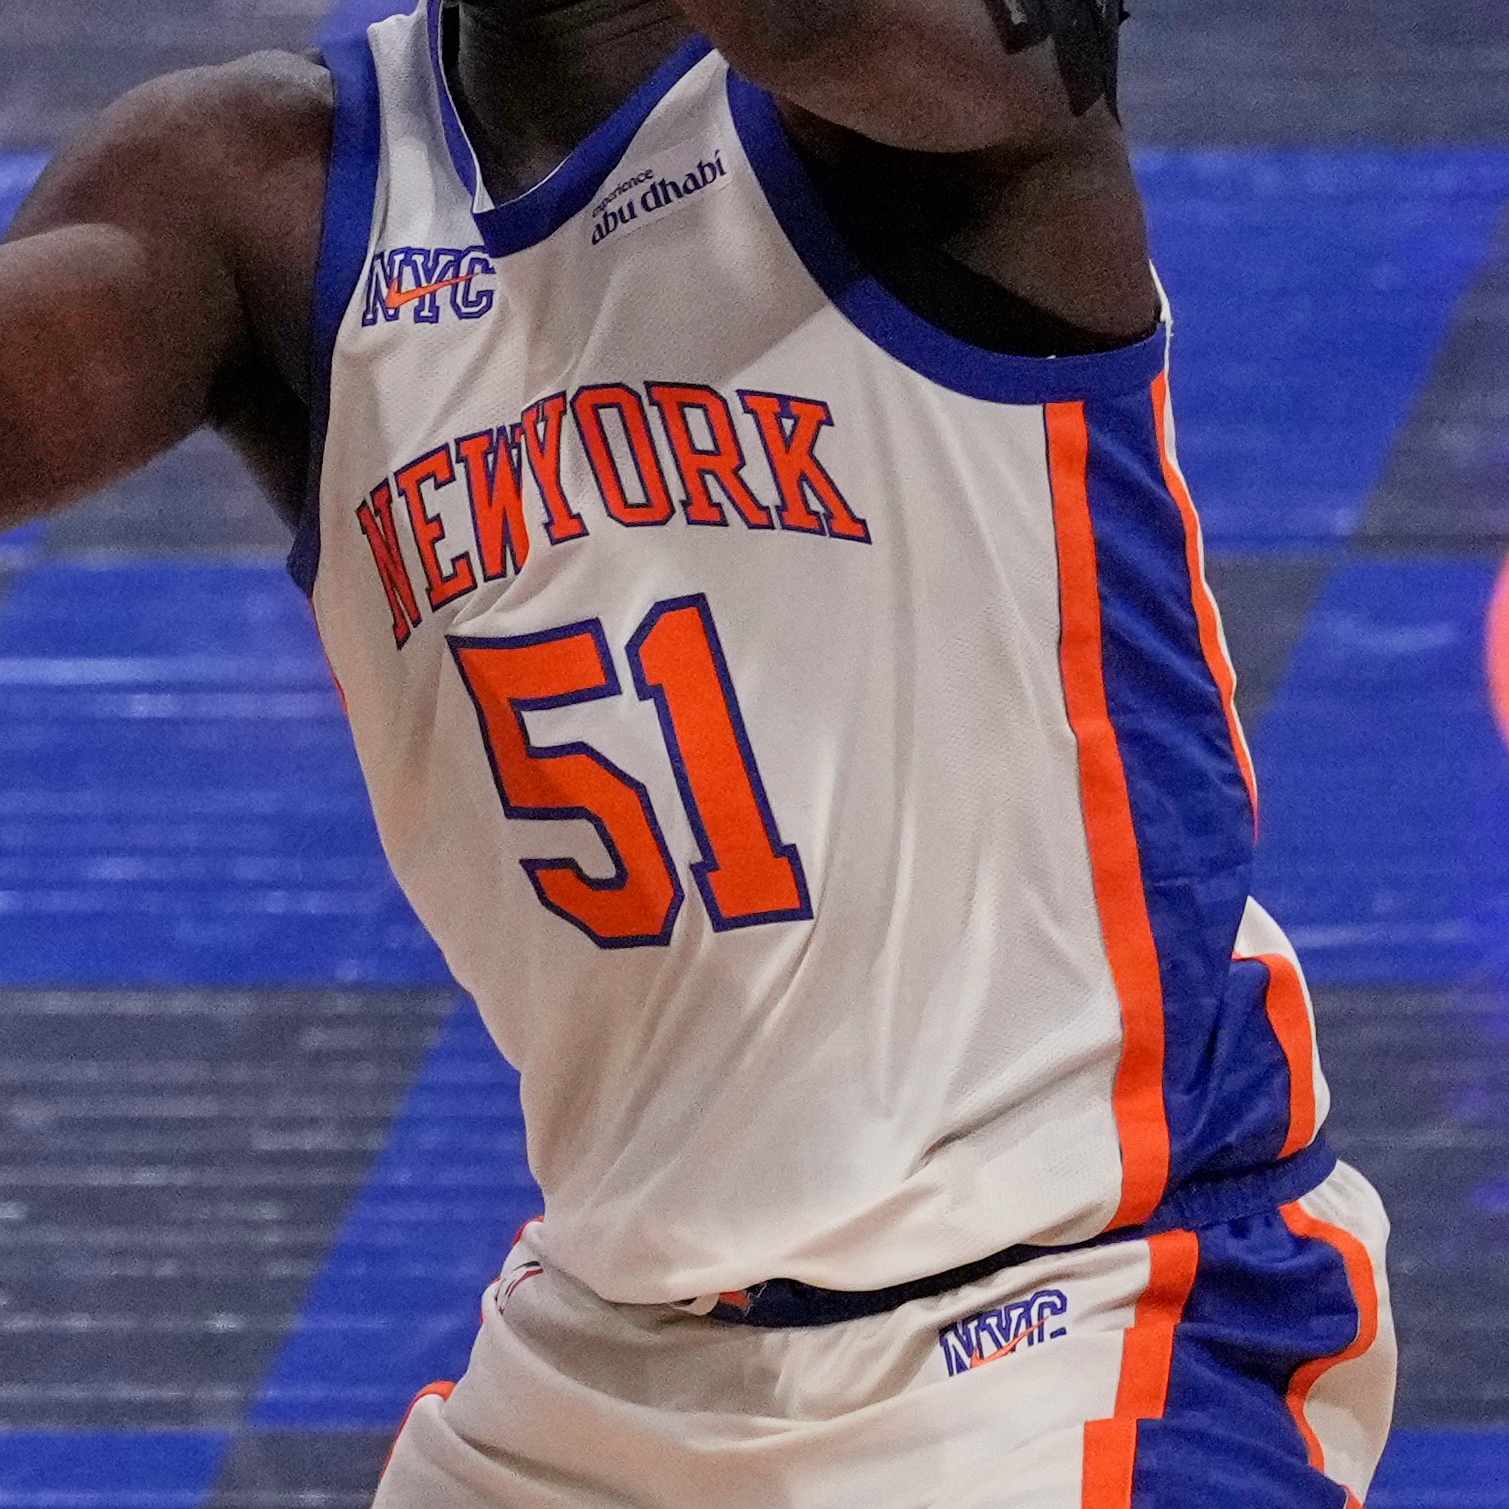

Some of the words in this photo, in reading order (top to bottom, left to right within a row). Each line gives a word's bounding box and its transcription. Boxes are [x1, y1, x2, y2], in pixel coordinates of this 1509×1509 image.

[591, 198, 638, 245] abu
[640, 149, 726, 212] dhabi
[361, 245, 497, 326] NYC
[356, 422, 530, 650] NEW
[520, 380, 872, 545] YORK
[444, 592, 814, 949] 51
[939, 1289, 1068, 1377] NYC
